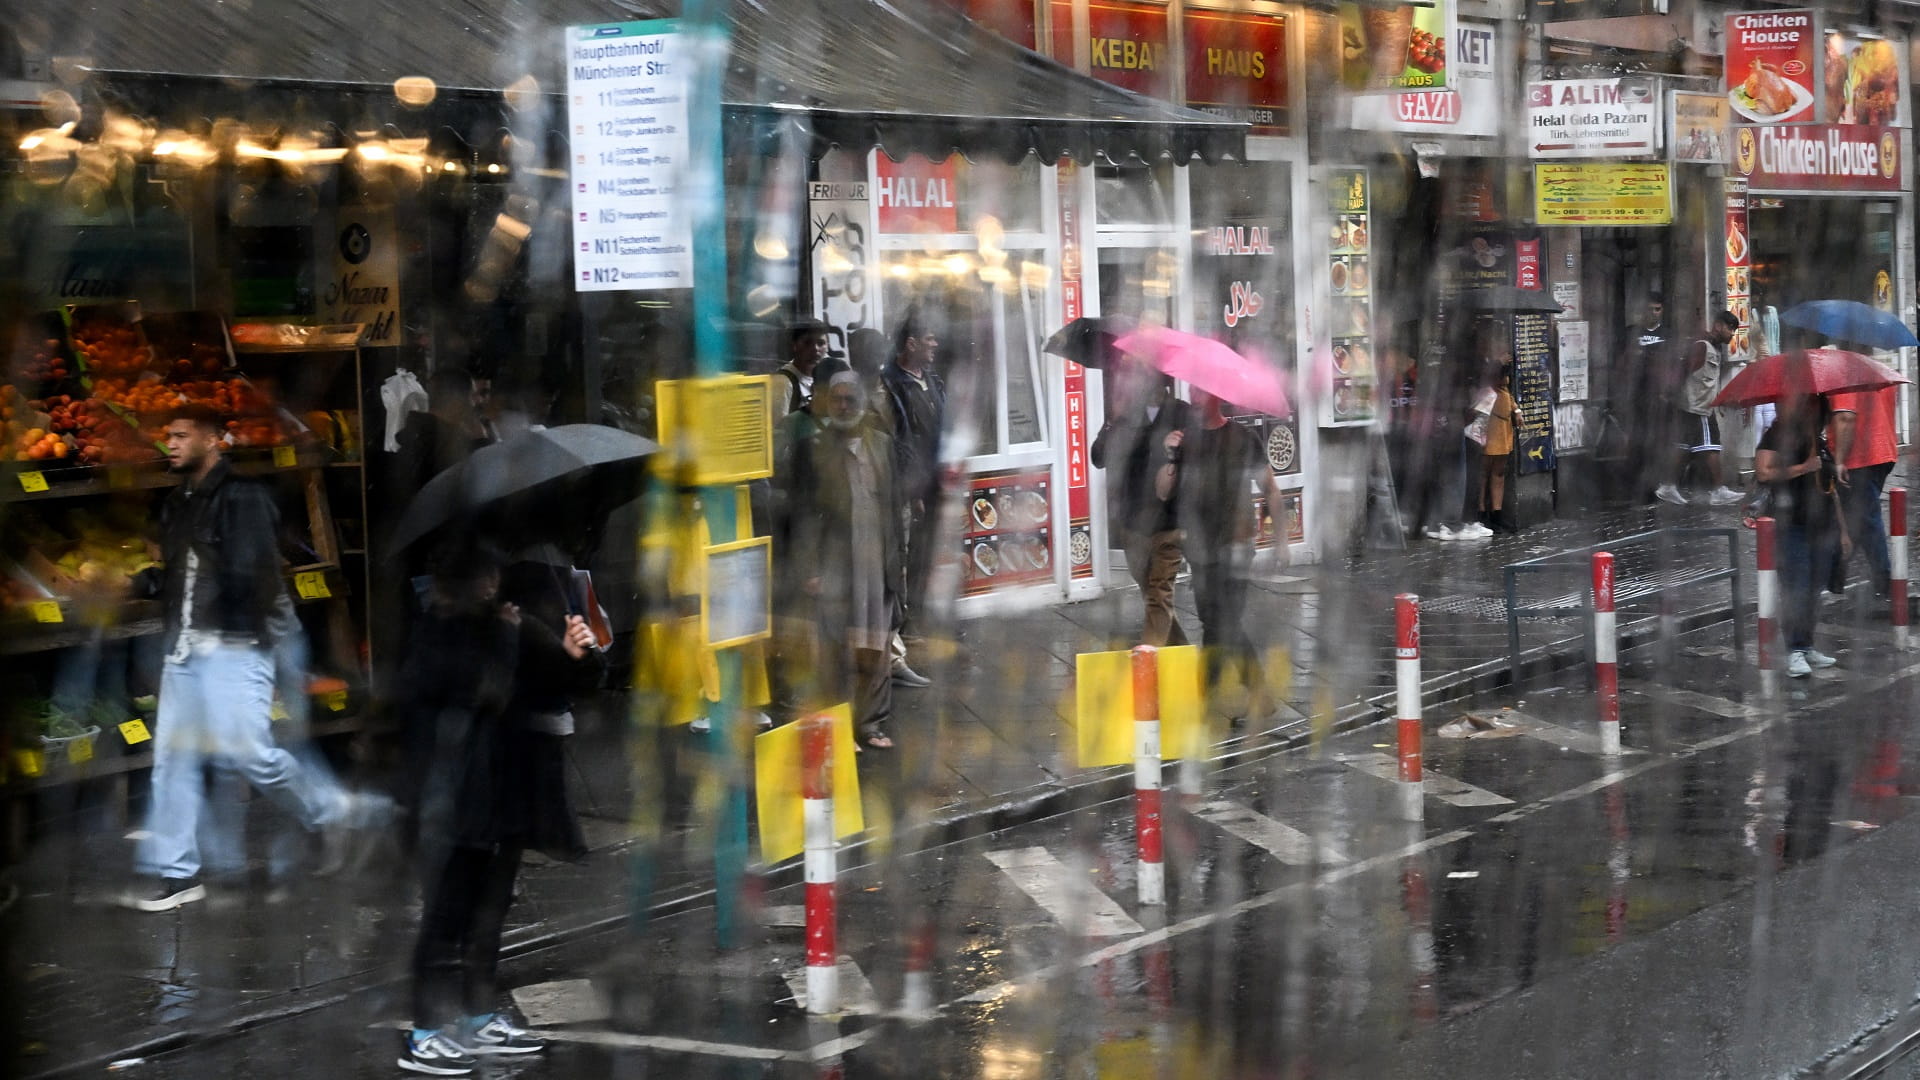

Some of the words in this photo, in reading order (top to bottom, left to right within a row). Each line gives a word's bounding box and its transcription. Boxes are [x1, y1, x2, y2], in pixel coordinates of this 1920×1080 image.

[1735, 15, 1807, 29] Chicken
[1742, 30, 1800, 44] House
[573, 40, 665, 61] Hauptbahnhof/
[1457, 29, 1491, 65] KET
[1207, 47, 1265, 79] HAUS
[574, 64, 642, 81] Münchener
[1399, 76, 1433, 86] HAUS
[598, 92, 613, 106] 11
[1397, 91, 1455, 122] GAZI
[598, 121, 613, 136] 12
[1533, 114, 1565, 127] Helal
[1760, 127, 1825, 174] Chicken
[1828, 129, 1878, 175] House
[598, 179, 615, 195] N4
[814, 184, 865, 199] FRISUR
[877, 176, 954, 208] HALAL
[1062, 198, 1074, 264] HELAL
[595, 238, 619, 254] N11
[1208, 227, 1274, 256] HALAL
[594, 267, 619, 284] N12
[1224, 280, 1264, 328] حلال
[1070, 398, 1080, 482] HELAL
